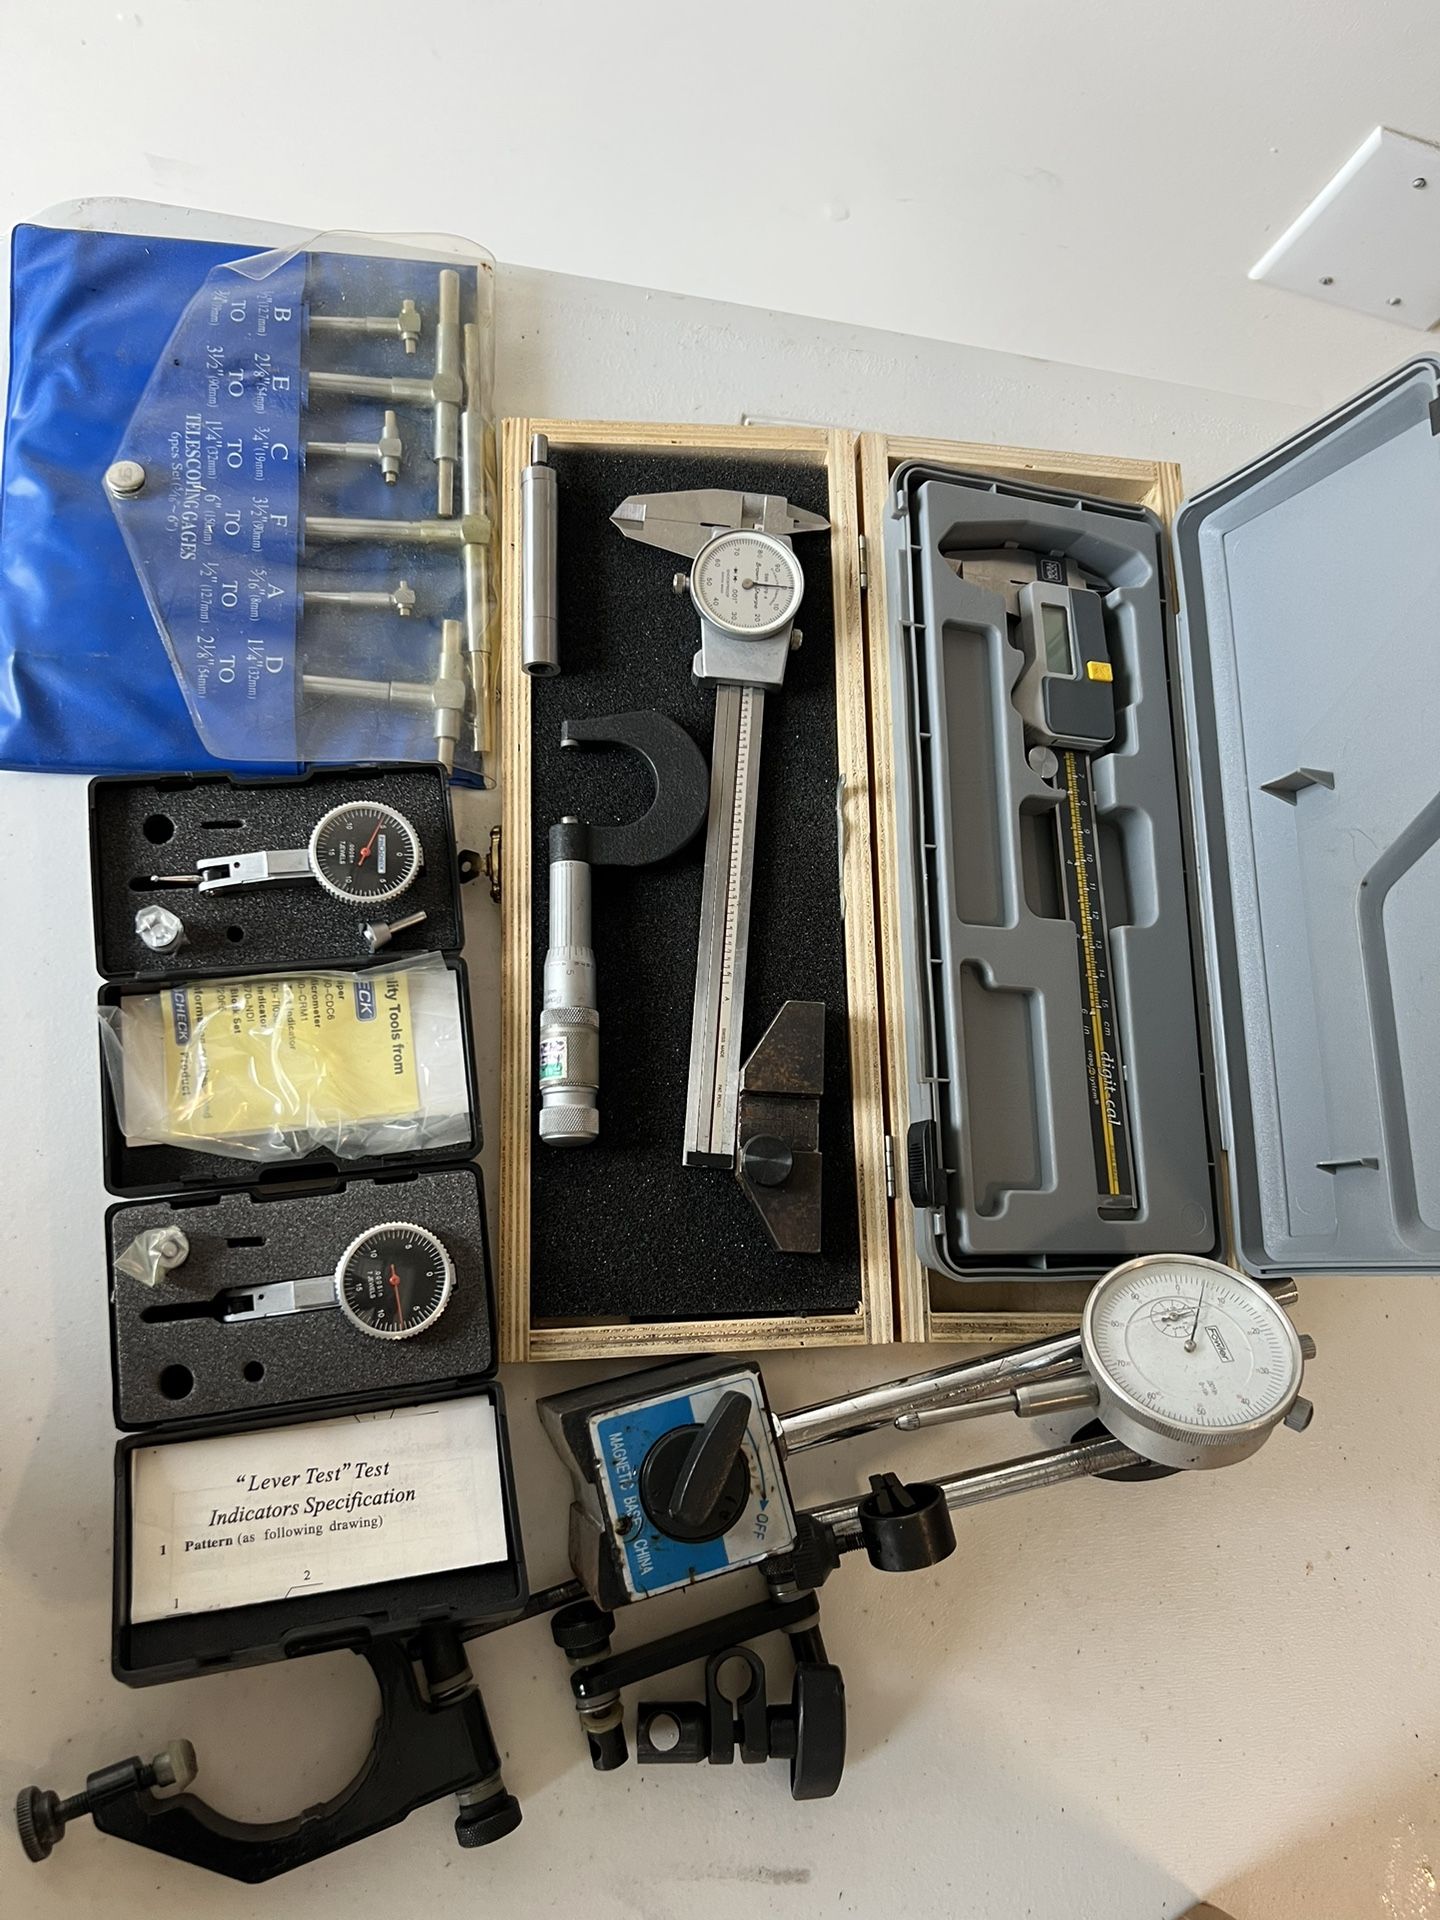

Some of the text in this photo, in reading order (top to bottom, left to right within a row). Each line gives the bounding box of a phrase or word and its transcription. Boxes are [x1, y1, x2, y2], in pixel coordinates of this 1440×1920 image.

[230, 300, 246, 322] TO
[274, 307, 291, 321] B
[228, 369, 243, 397] TO
[273, 376, 289, 391] E
[169, 432, 182, 458] 6pcs
[227, 438, 242, 469] TO
[271, 443, 288, 460] C
[171, 463, 182, 480] Set
[180, 413, 203, 560] TELESCOPING GAGES
[224, 510, 241, 536] TO
[270, 514, 288, 527] F
[222, 581, 237, 607] TO
[268, 583, 284, 599] A
[219, 655, 235, 683] TO
[266, 657, 283, 673] D
[1086, 853, 1093, 863] 10
[1089, 882, 1096, 891] 11
[1092, 910, 1099, 920] 12
[1095, 940, 1102, 949] 13
[1098, 969, 1105, 978] 14
[230, 988, 241, 1034] Blok Set
[257, 986, 268, 1028] Indicator
[1101, 999, 1112, 1036] 15 cm
[387, 1004, 401, 1040] Tools
[1083, 1024, 1091, 1035] in
[392, 1044, 404, 1075] from
[179, 1051, 191, 1096] Product
[370, 1250, 377, 1258] 10
[356, 1283, 362, 1292] 15
[377, 1310, 384, 1318] 10
[1208, 1327, 1229, 1361] Fowler
[354, 1460, 391, 1480] Test
[208, 1486, 417, 1528] Indicators Specification
[609, 1432, 634, 1491] MAGNETIC
[633, 1539, 654, 1576] CHINA
[184, 1535, 234, 1552] Pattern
[237, 1531, 255, 1546] (as
[264, 1522, 323, 1541] following
[329, 1515, 384, 1533] drawing)
[753, 1513, 769, 1540] OFF
[303, 1569, 311, 1581] 2
